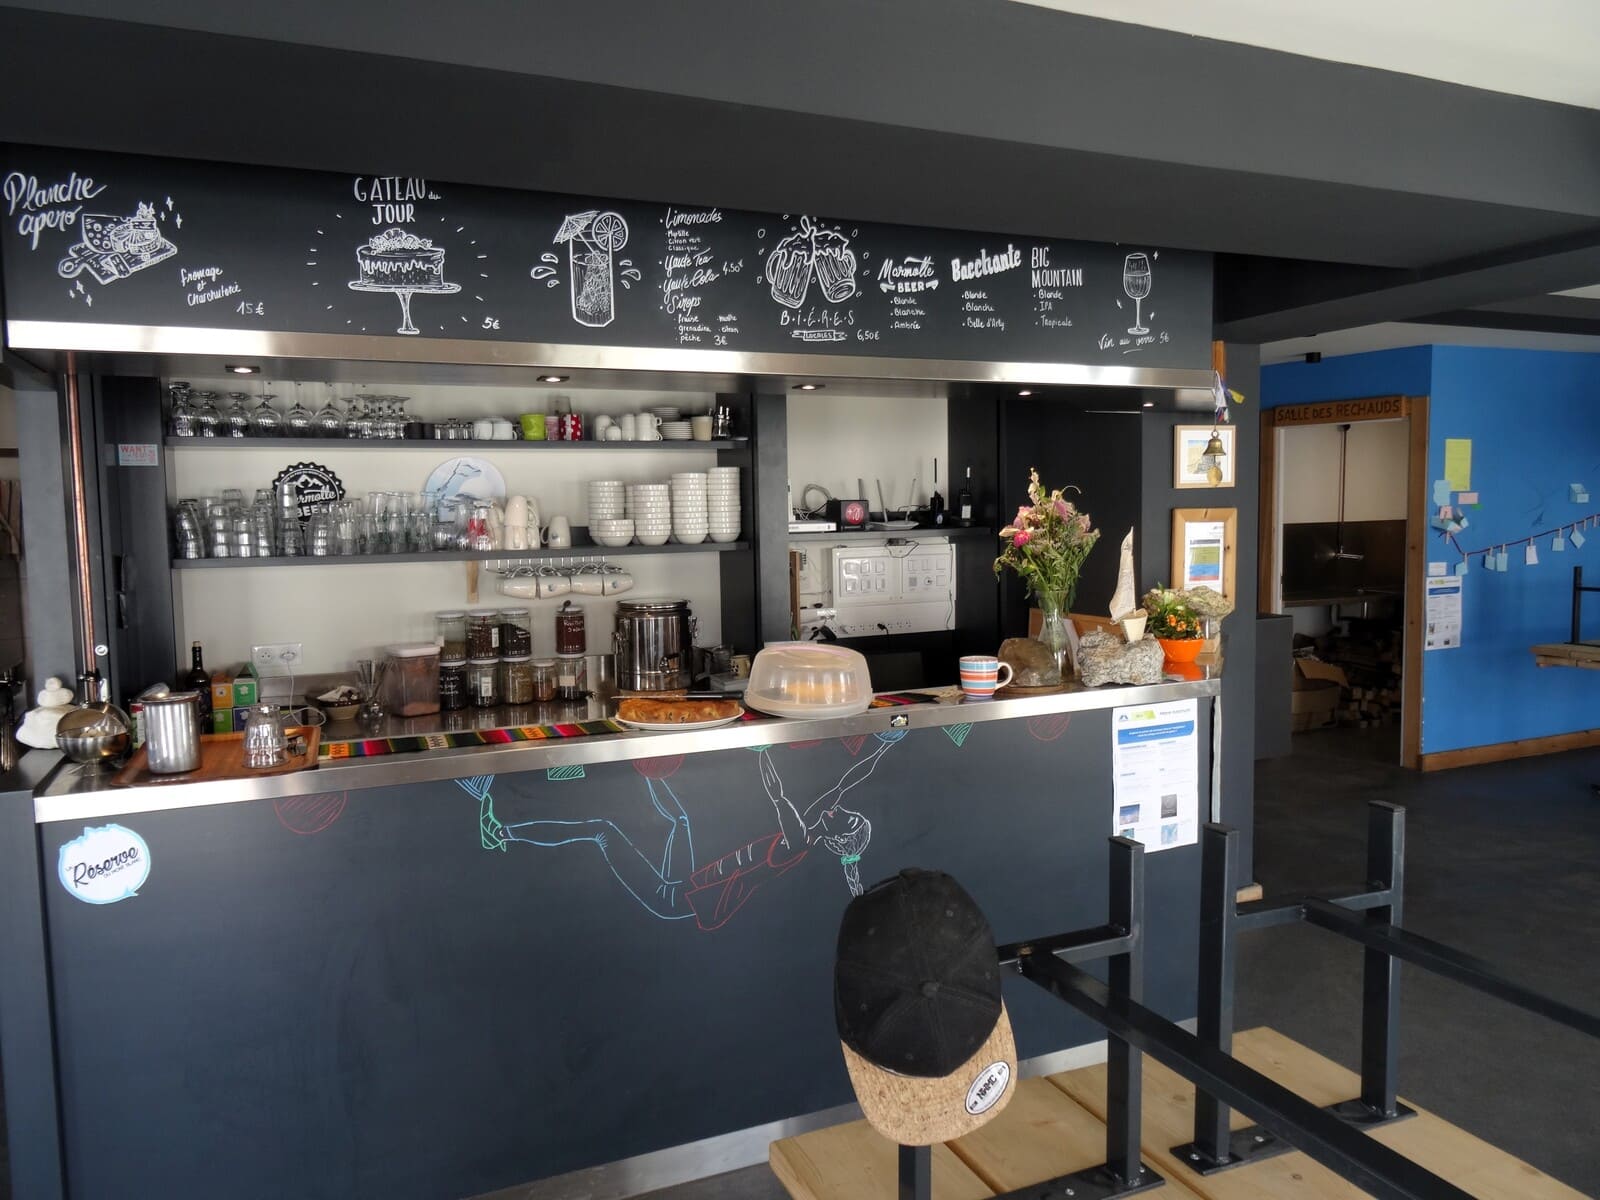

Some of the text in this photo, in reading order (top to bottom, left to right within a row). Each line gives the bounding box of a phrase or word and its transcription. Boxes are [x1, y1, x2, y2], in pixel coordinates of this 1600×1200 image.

[4, 172, 107, 216] Planche
[354, 177, 426, 201] GATEAU
[372, 203, 415, 224] JOUR
[666, 208, 722, 228] Limonades
[951, 244, 1021, 282] Bacchante
[1031, 247, 1050, 269] BIG
[878, 256, 934, 284] Marmotte
[1031, 269, 1082, 288] MOUNTAIN
[897, 282, 924, 293] BEER
[1038, 289, 1063, 300] Blonde
[1039, 301, 1053, 312] IPA
[482, 317, 500, 329] 5€
[1098, 332, 1115, 350] Vin
[1277, 407, 1310, 421] SALLE
[1312, 407, 1333, 419] DES
[74, 847, 138, 888] Réserve
